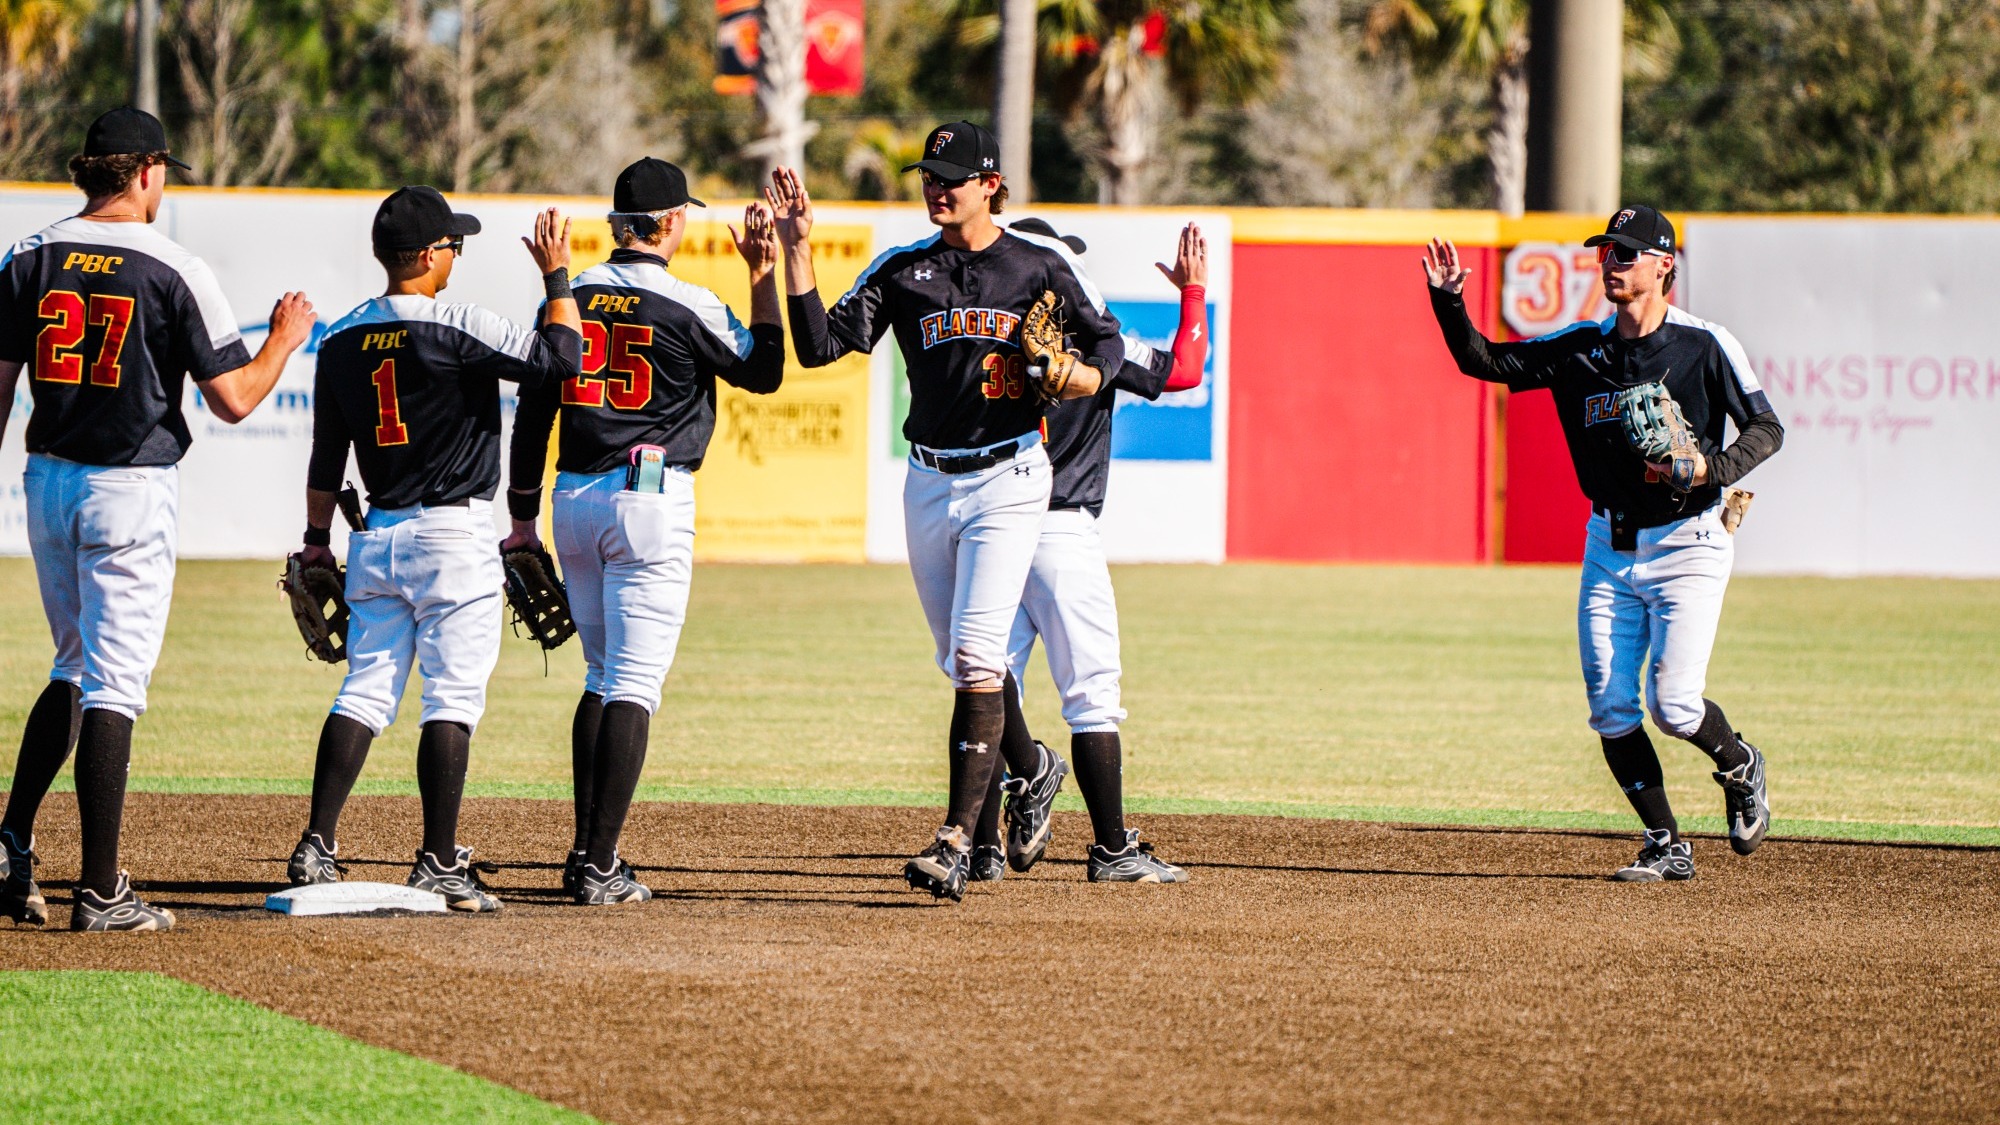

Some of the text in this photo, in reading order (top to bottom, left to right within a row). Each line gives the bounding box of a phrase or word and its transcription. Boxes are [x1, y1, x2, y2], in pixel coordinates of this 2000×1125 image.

[63, 252, 124, 275] PBC
[1516, 250, 1604, 323] 37
[588, 294, 641, 314] PBC
[36, 289, 135, 388] 27
[362, 329, 408, 351] PBC
[561, 320, 654, 409] 25
[371, 358, 409, 447] 1
[981, 353, 1026, 399] 39
